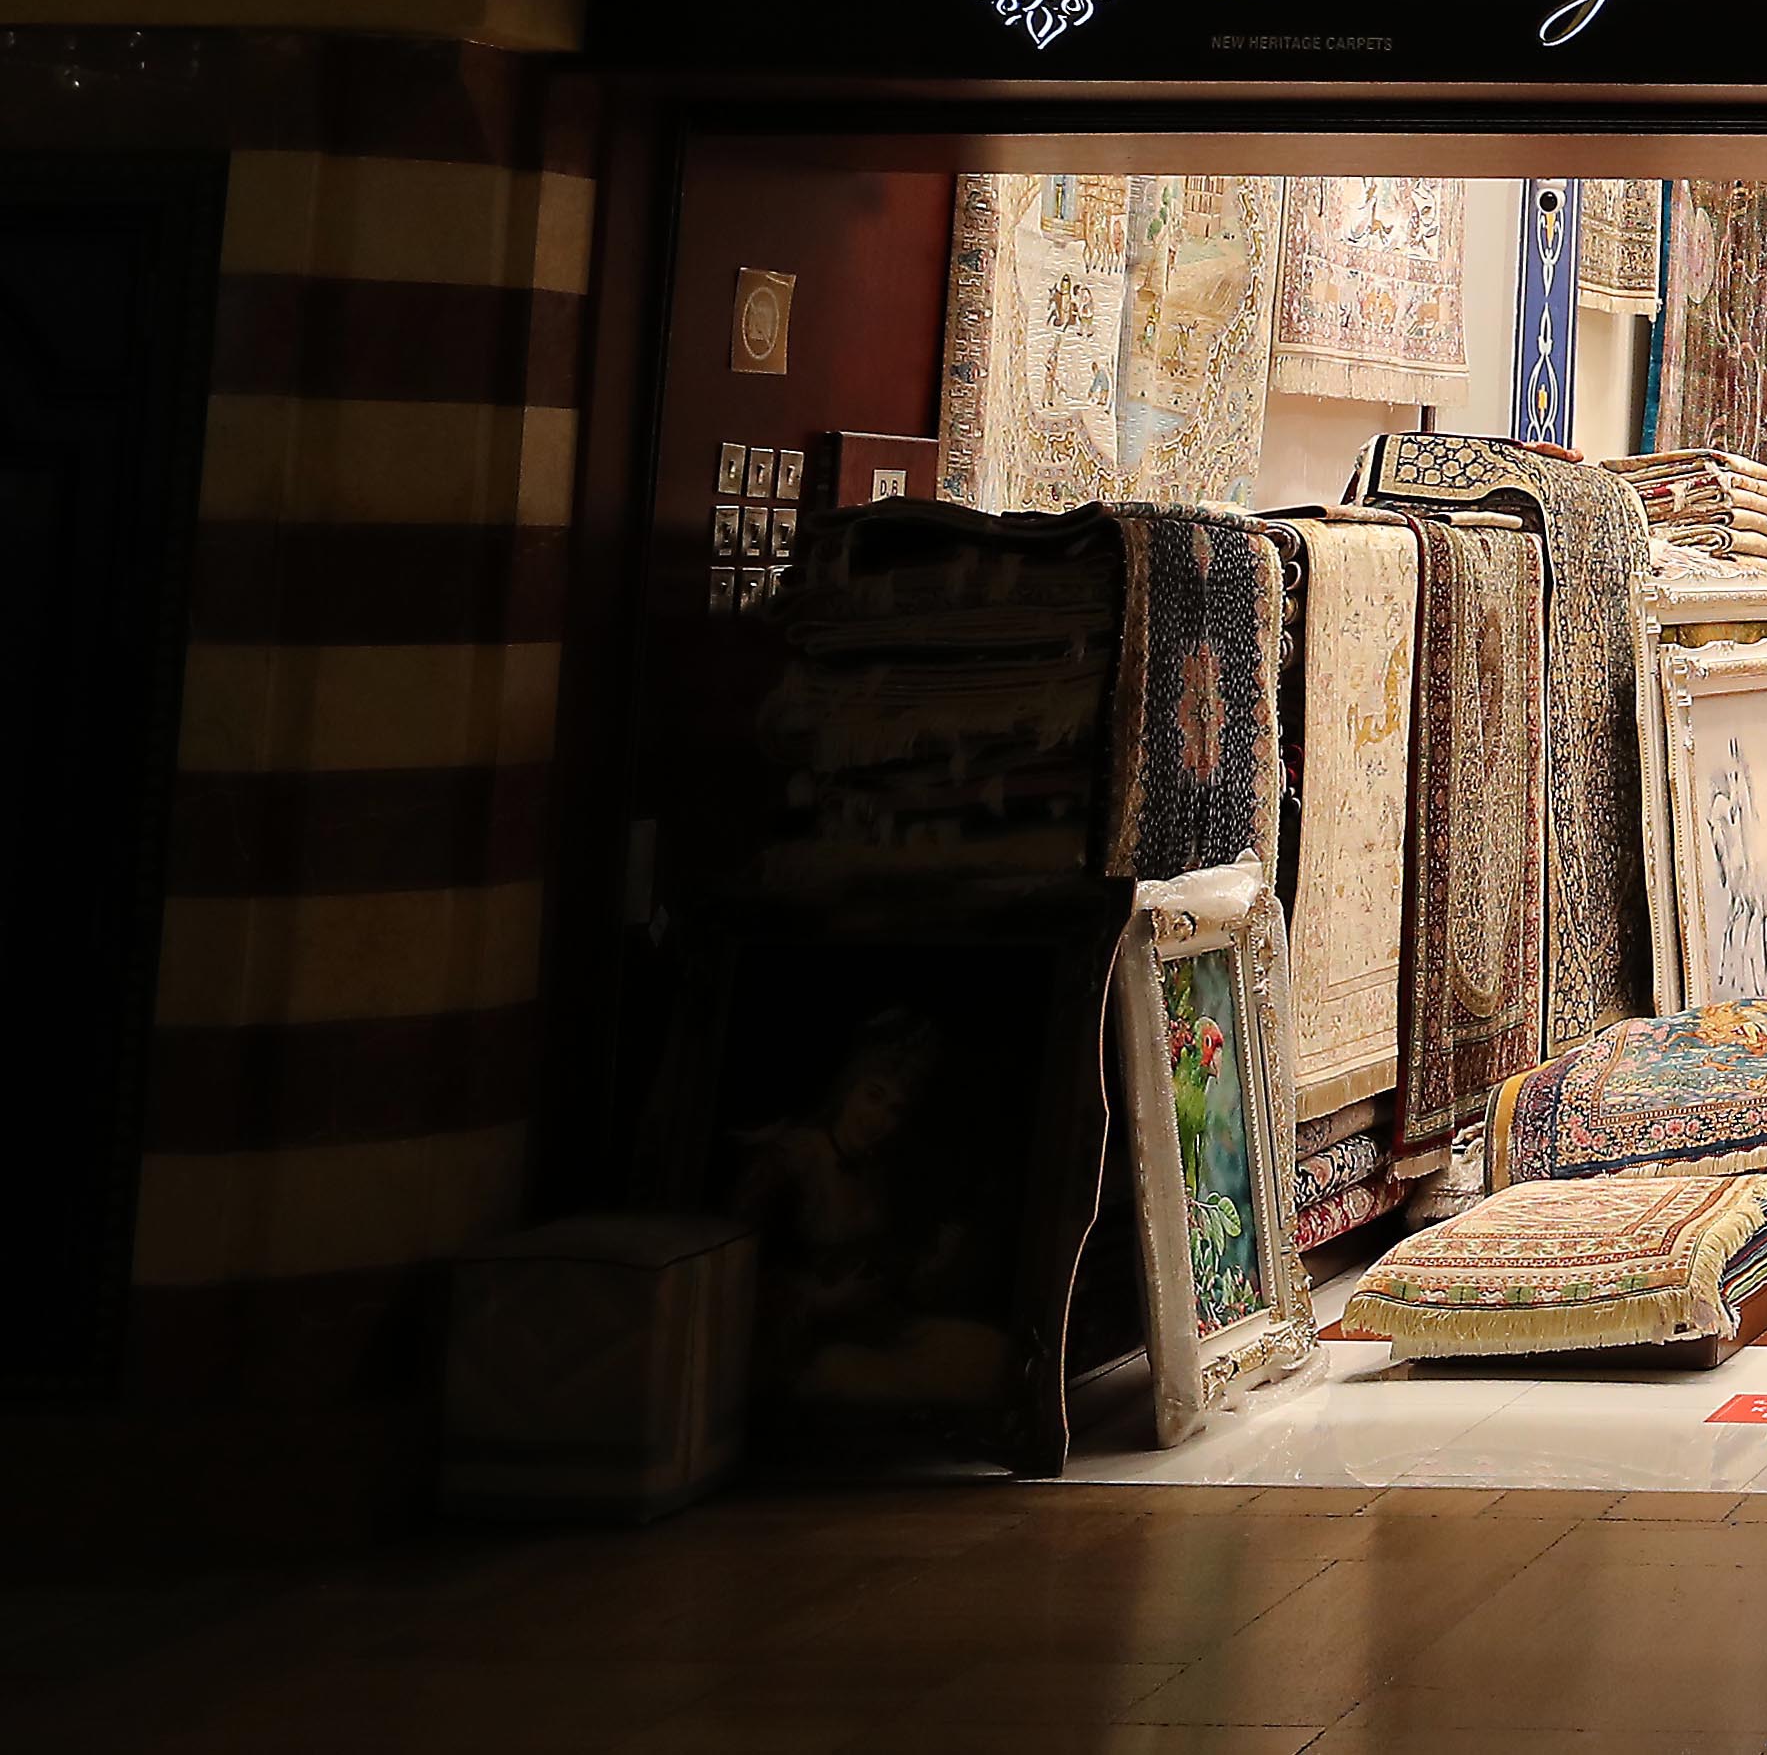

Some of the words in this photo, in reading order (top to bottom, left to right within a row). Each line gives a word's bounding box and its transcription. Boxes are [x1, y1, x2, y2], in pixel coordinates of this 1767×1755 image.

[1210, 35, 1245, 50] NEW
[1248, 35, 1321, 51] HERITAGE
[1325, 36, 1393, 52] CARPETS
